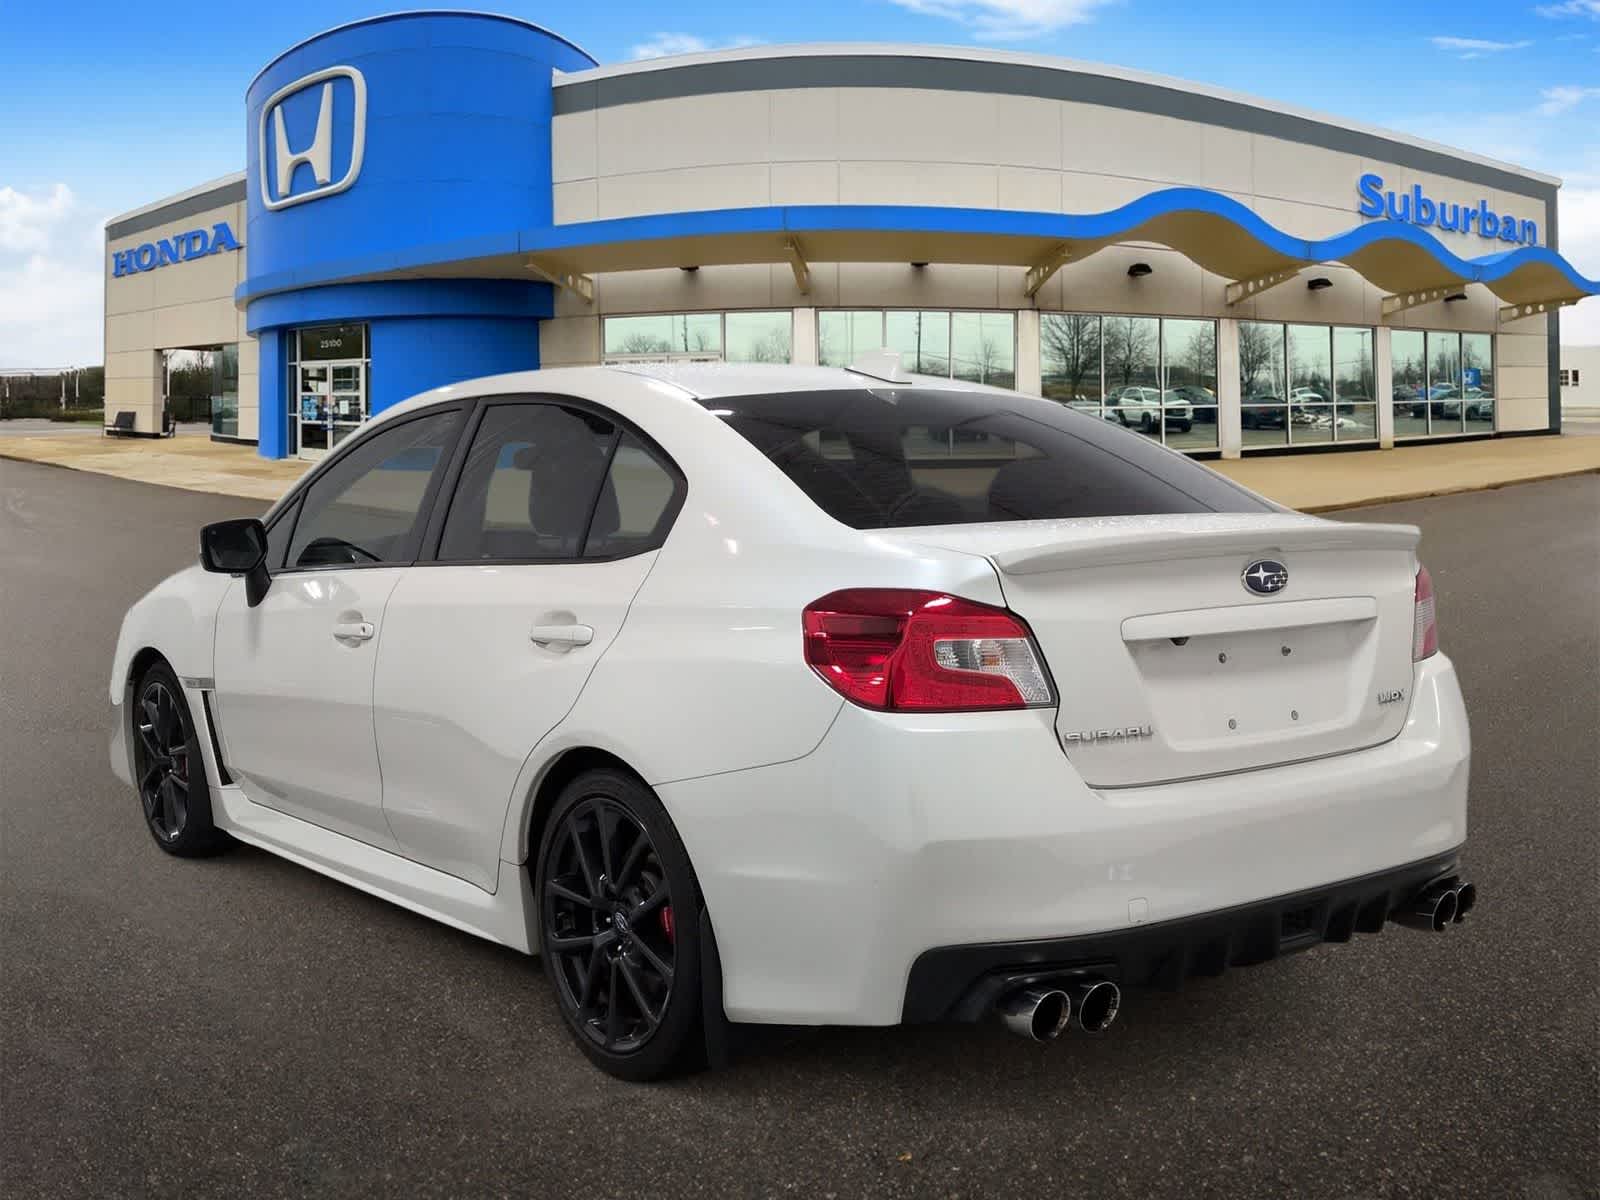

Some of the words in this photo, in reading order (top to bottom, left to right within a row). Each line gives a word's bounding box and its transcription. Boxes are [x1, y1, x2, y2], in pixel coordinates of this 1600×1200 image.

[1358, 173, 1537, 245] Suburban
[112, 221, 241, 278] HONDA
[1064, 726, 1152, 743] SUBARU
